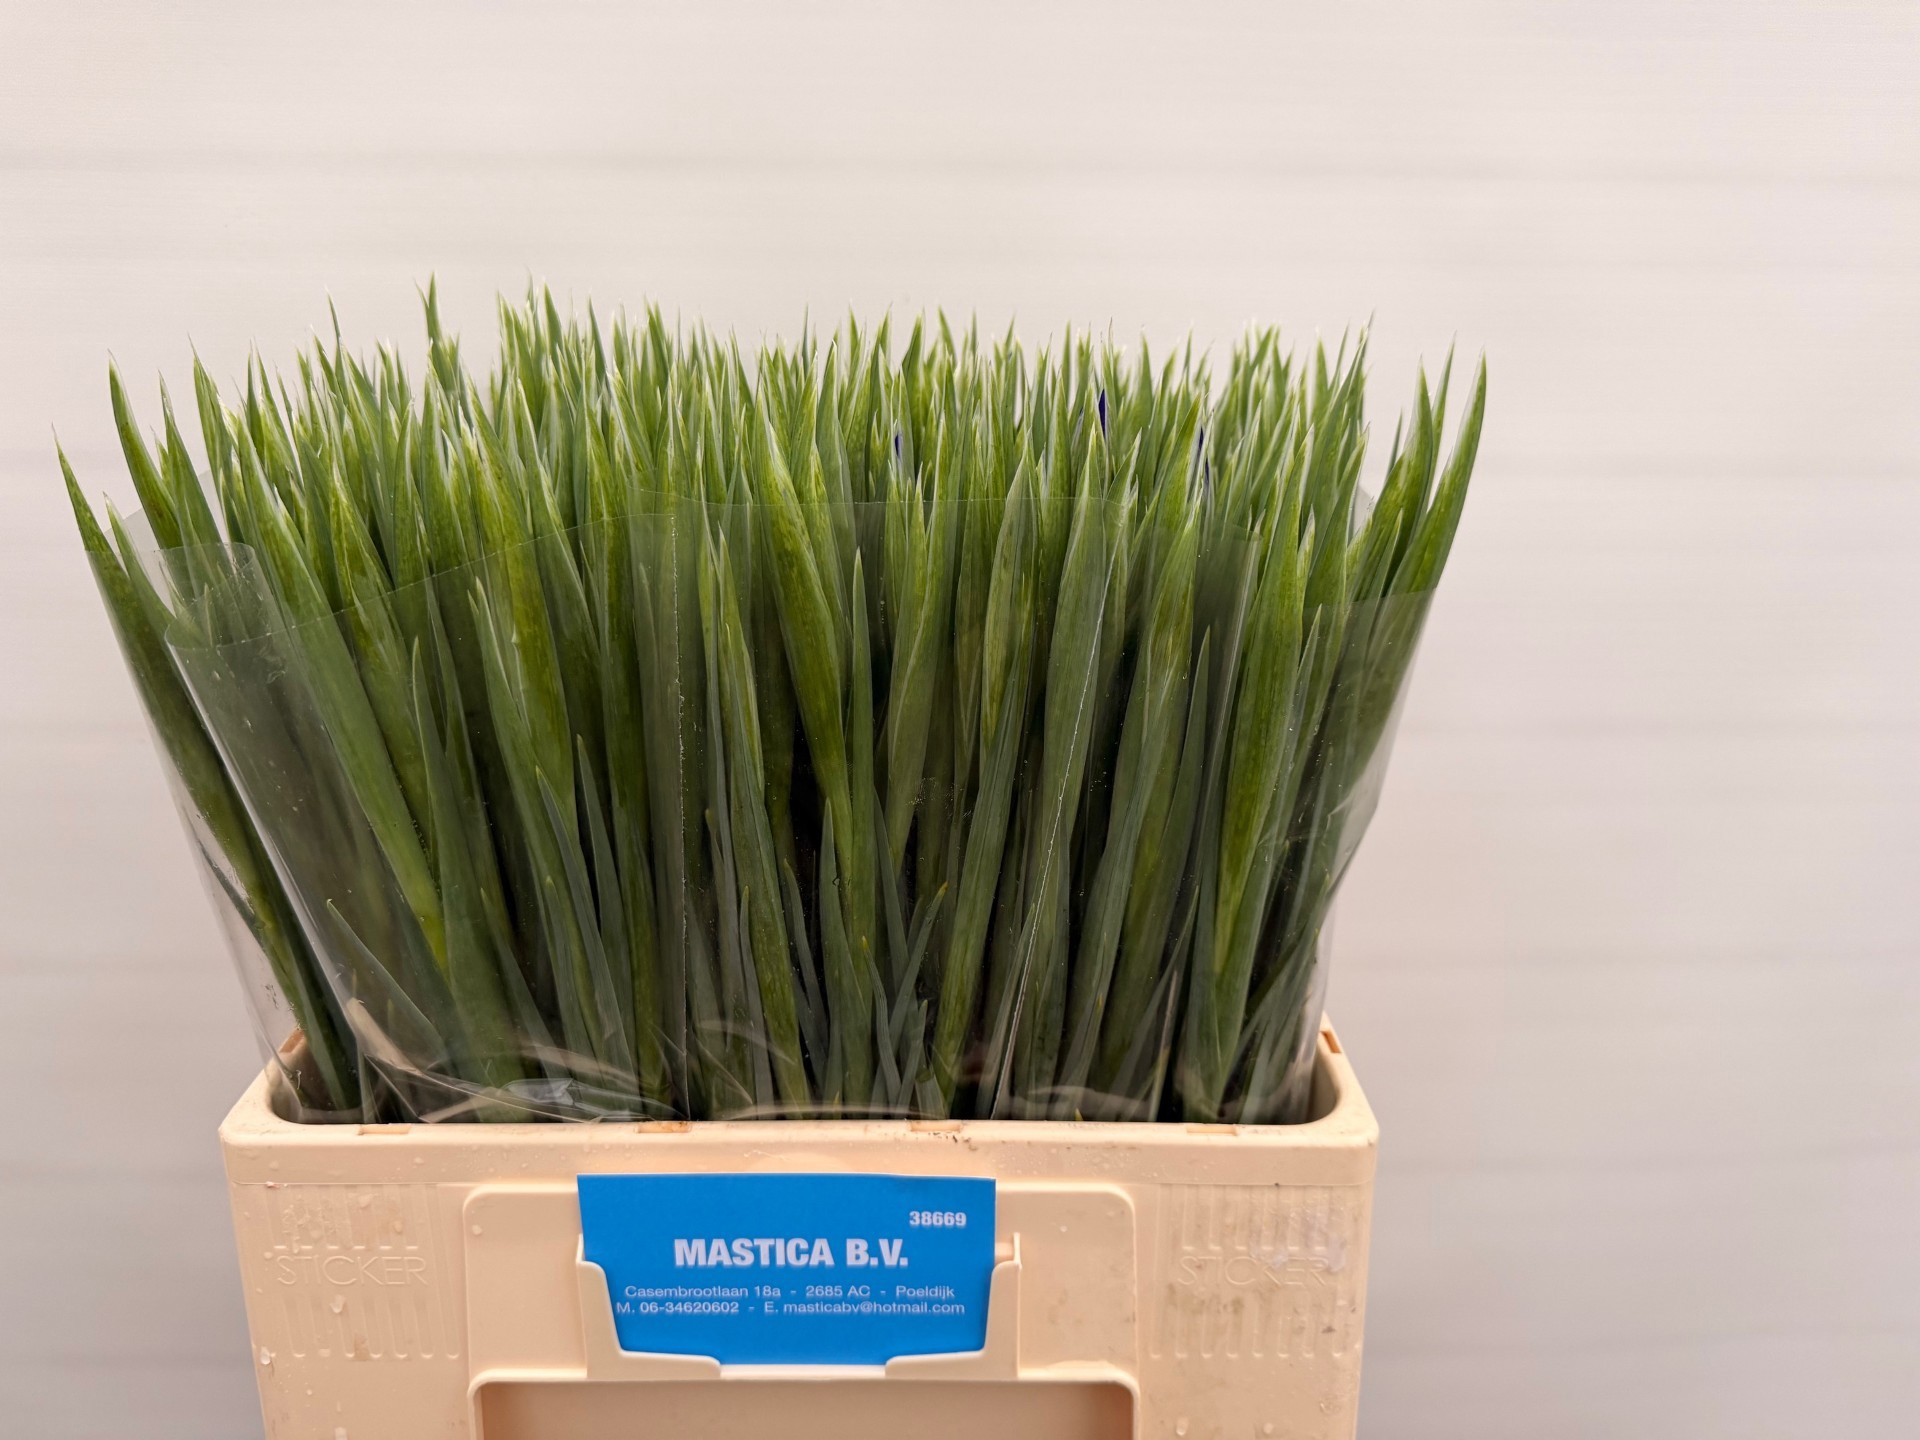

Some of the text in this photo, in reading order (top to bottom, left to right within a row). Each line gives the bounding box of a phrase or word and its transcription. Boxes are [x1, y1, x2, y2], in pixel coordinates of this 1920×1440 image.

[909, 1210, 967, 1227] 38669
[673, 1237, 909, 1268] MASTICA B.V.
[275, 1254, 429, 1286] STICKER
[624, 1285, 749, 1298] Casembrootlaan
[754, 1285, 782, 1298] 18a
[805, 1285, 843, 1298] 2685
[847, 1285, 871, 1298] AC
[895, 1285, 955, 1300] Poeldijk
[616, 1301, 635, 1314] M.
[639, 1301, 739, 1314] 06-34620602
[764, 1301, 779, 1314] E.
[783, 1301, 965, 1314] masticabv@hotmail.com
